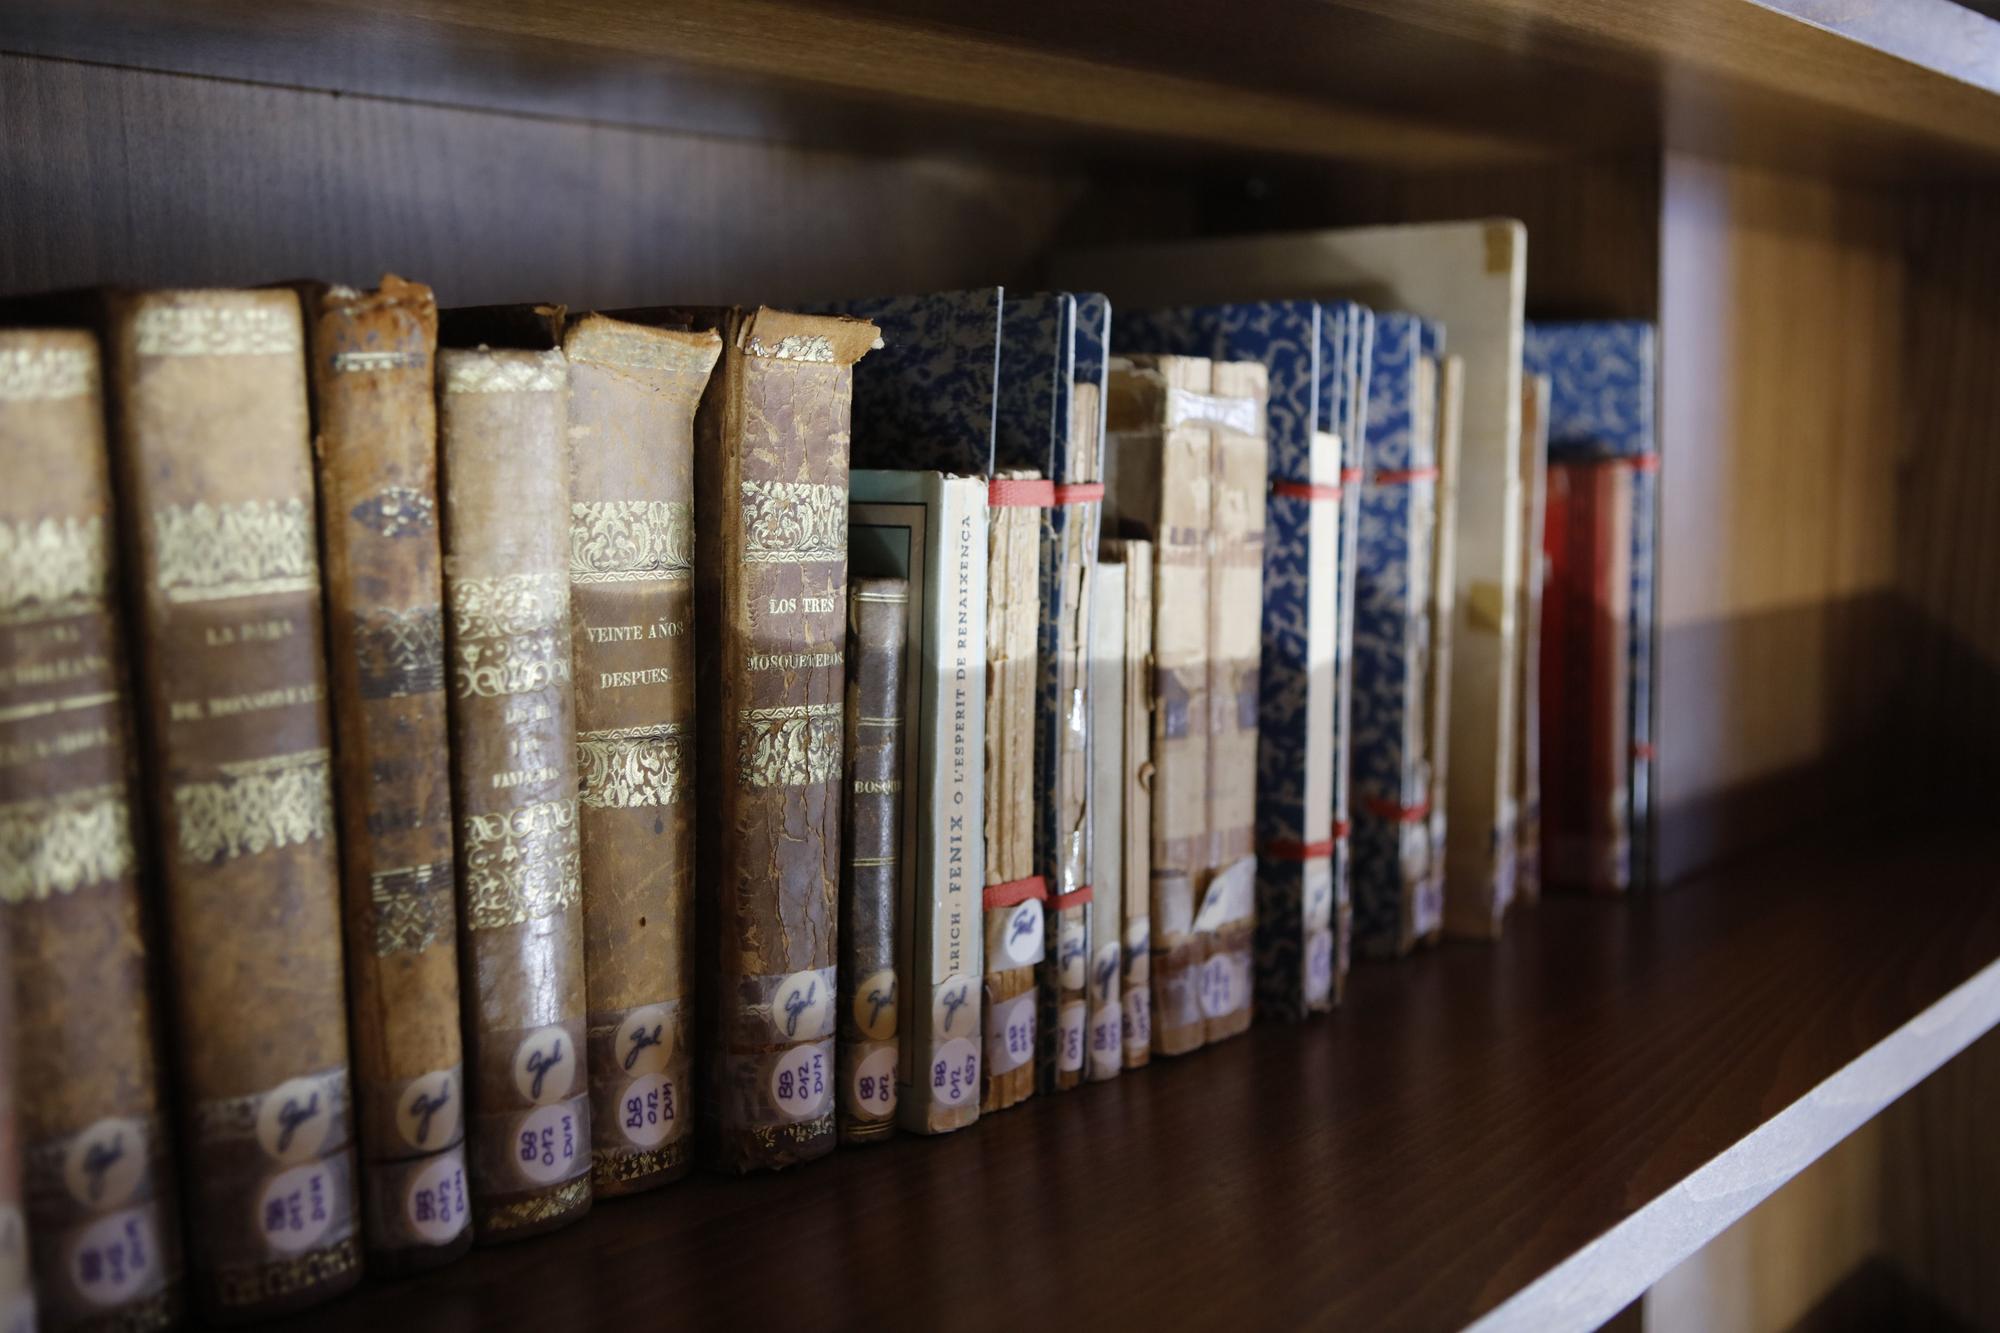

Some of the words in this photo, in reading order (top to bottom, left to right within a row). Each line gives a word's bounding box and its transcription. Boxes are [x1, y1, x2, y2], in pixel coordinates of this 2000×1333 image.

[958, 515, 971, 650] RENAIXENÇA
[768, 598, 797, 614] LOS
[802, 597, 835, 613] TRES
[588, 625, 643, 643] VEINTE
[648, 616, 684, 639] AÑOS
[957, 657, 967, 681] DE
[954, 689, 966, 783] L'ESPERIT
[954, 791, 964, 805] O
[950, 815, 963, 893] FENIX
[777, 1069, 795, 1100] BB
[798, 1060, 810, 1100] 012
[813, 1053, 825, 1096] DUM
[859, 1074, 876, 1100] BB
[879, 1073, 890, 1102] 012
[950, 1066, 961, 1100] 012
[626, 1096, 644, 1129] BB
[647, 1086, 659, 1126] 012
[662, 1082, 675, 1120] DUM
[521, 1130, 538, 1161] BB
[541, 1126, 555, 1167] 012
[561, 1115, 574, 1159] DUM
